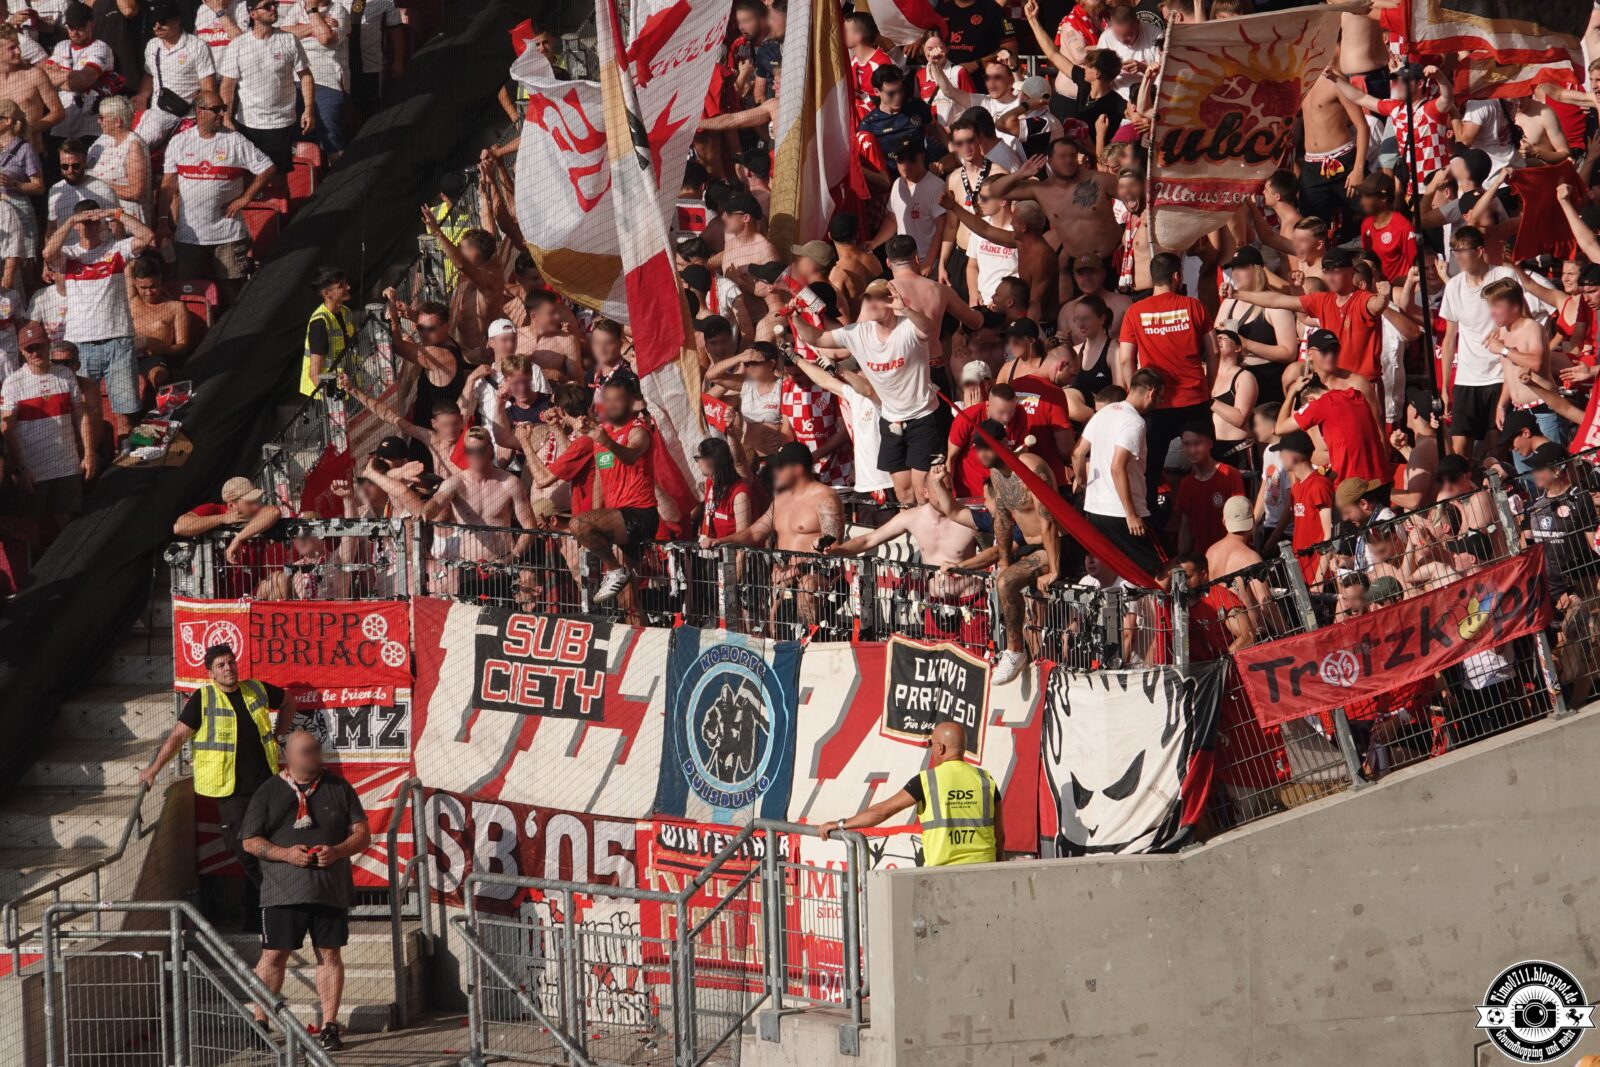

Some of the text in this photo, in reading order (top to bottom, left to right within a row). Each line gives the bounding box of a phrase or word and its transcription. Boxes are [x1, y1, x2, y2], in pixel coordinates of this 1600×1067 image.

[1144, 322, 1190, 336] moguntia
[502, 613, 594, 664] SUB
[701, 646, 767, 677] KOHORTE
[914, 657, 967, 692] CURVA
[322, 689, 337, 702] be
[340, 686, 388, 704] friends
[481, 659, 605, 714] CIETY
[333, 701, 408, 749] MZ
[682, 758, 770, 808] DUISBURG
[947, 789, 975, 800] SDS
[948, 830, 976, 845] 1077
